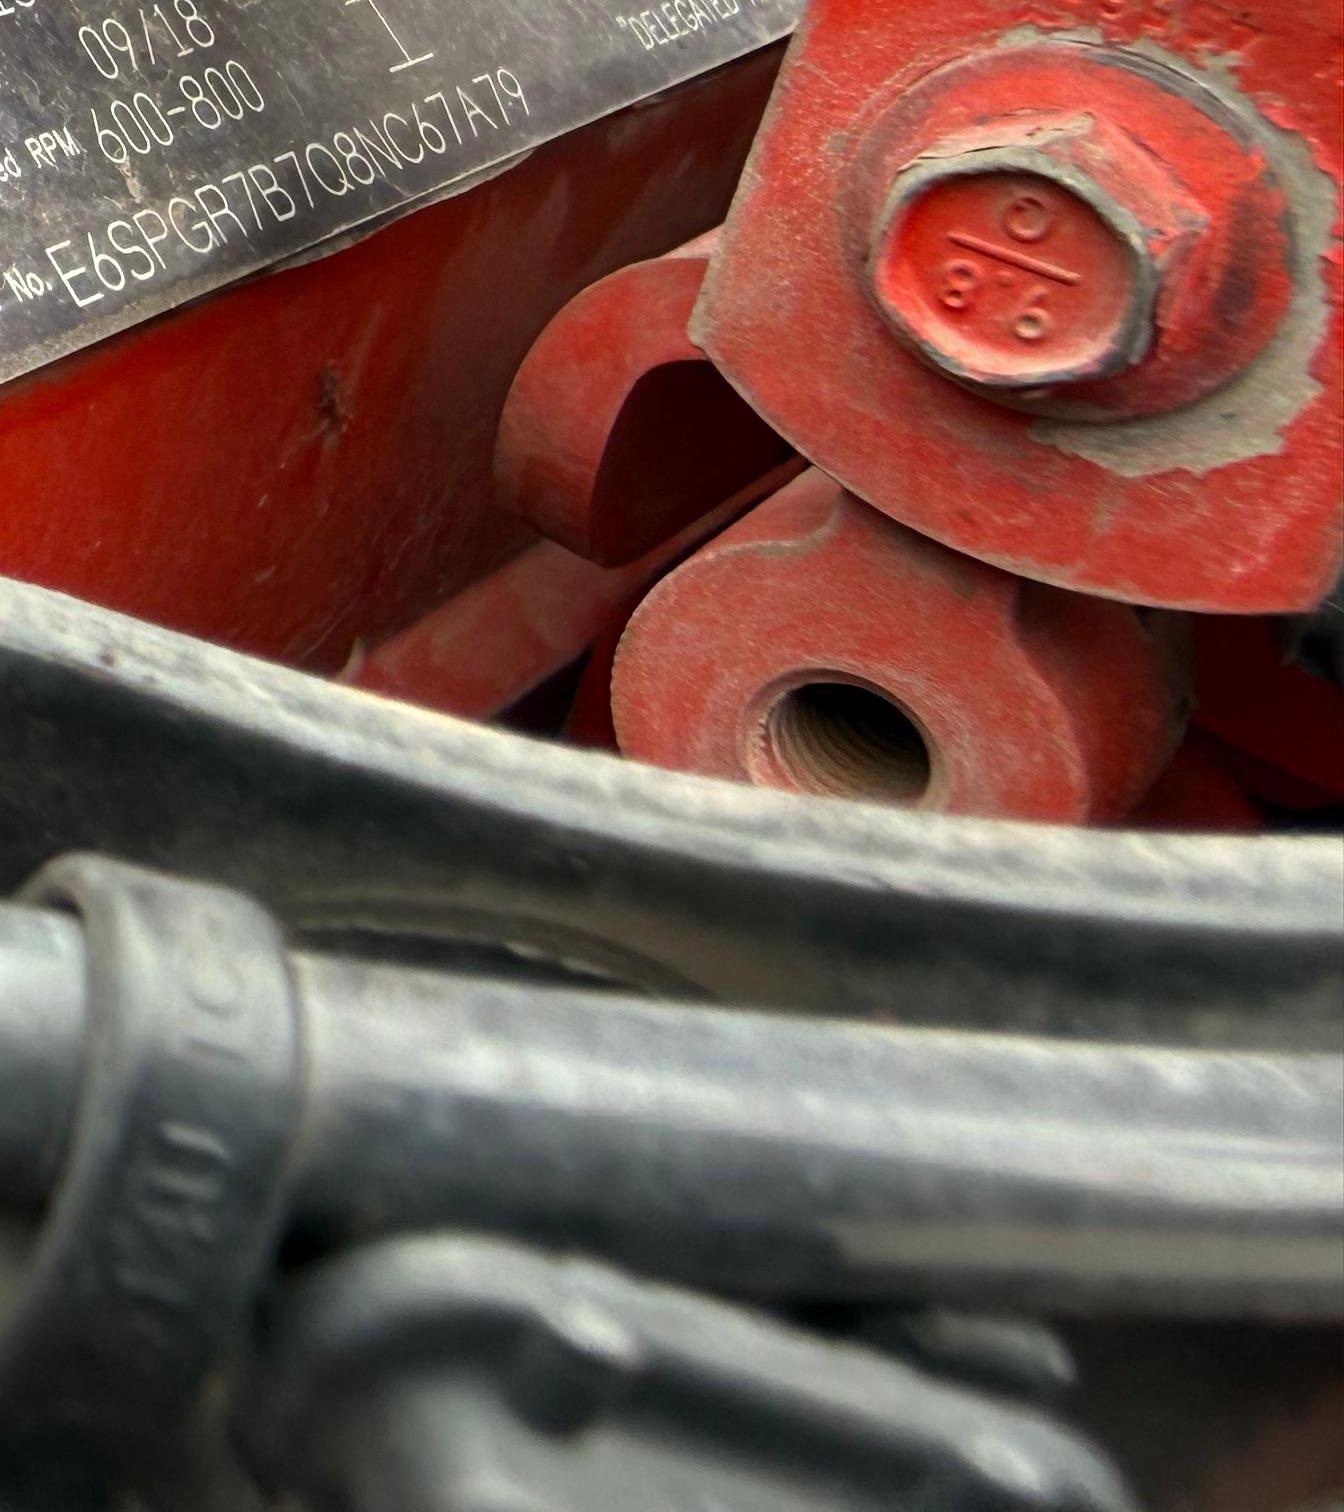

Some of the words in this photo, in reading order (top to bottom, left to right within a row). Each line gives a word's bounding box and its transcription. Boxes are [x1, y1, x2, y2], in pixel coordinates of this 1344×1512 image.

[4, 264, 52, 303] No.
[45, 66, 531, 308] E6SPGR7B7Q8NC67A79
[25, 126, 81, 169] RPM
[91, 59, 265, 164] 600-800
